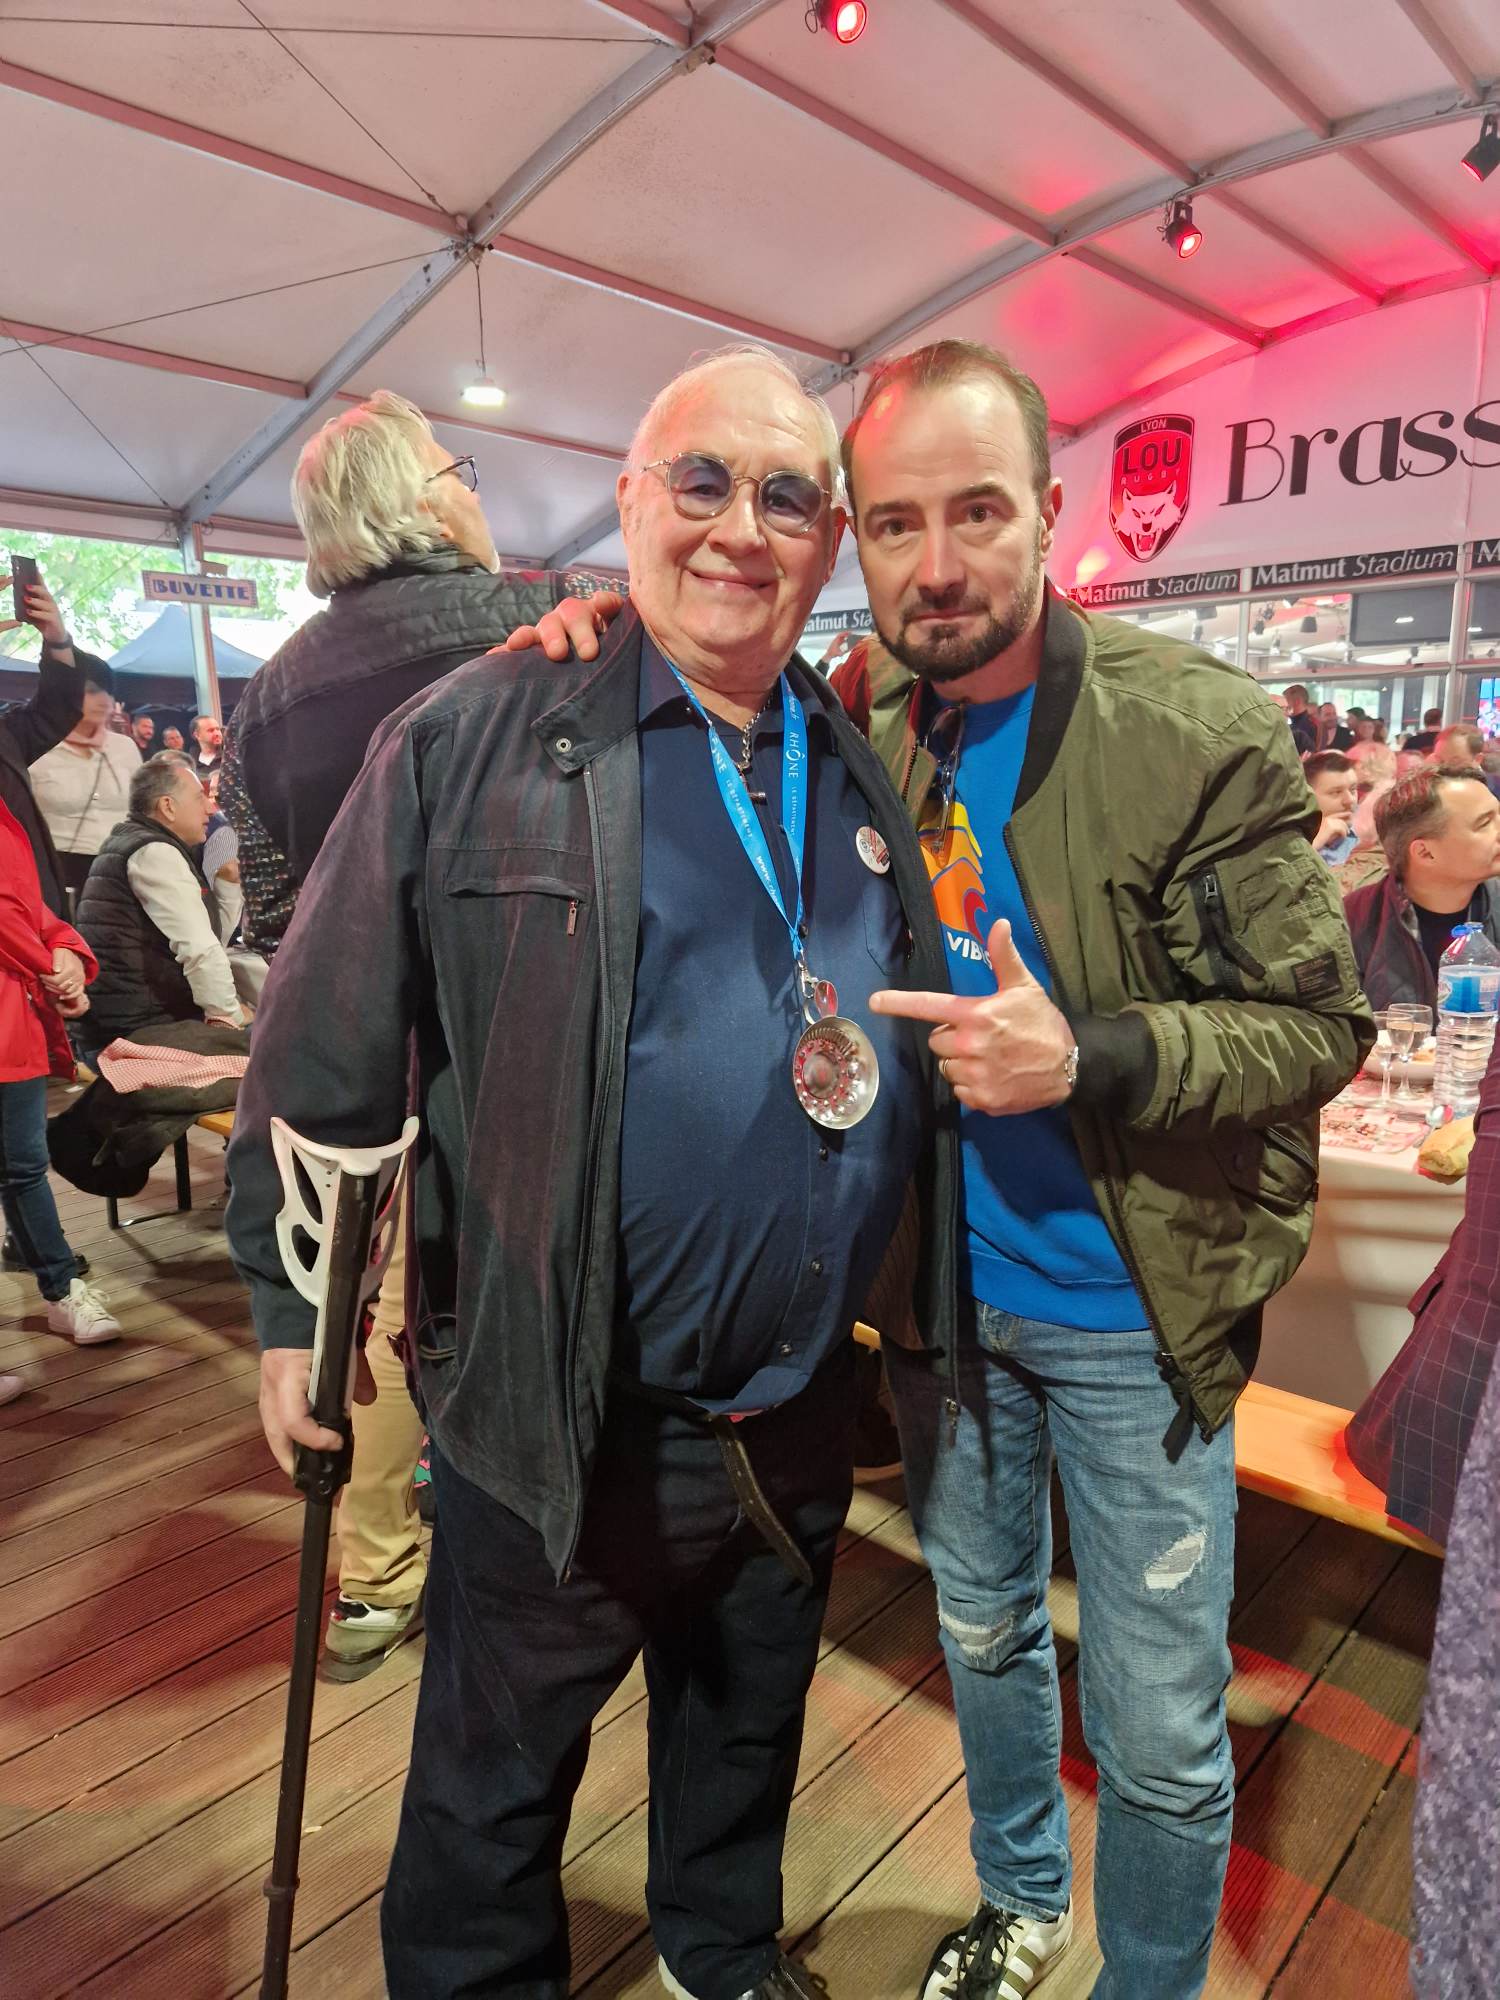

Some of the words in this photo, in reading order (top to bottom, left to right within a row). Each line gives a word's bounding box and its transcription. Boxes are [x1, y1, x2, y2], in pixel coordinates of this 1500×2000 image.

[1140, 418, 1168, 433] LYON
[1122, 437, 1182, 474] LOU
[1120, 468, 1180, 486] RUGBY
[1255, 559, 1347, 586] Matmut
[1352, 549, 1454, 578] Stadium
[152, 579, 250, 600] BUVETTE
[1077, 580, 1150, 604] Matmut
[1155, 572, 1238, 597] Stadium
[806, 613, 849, 632] atmut
[785, 731, 805, 778] RHÔNE
